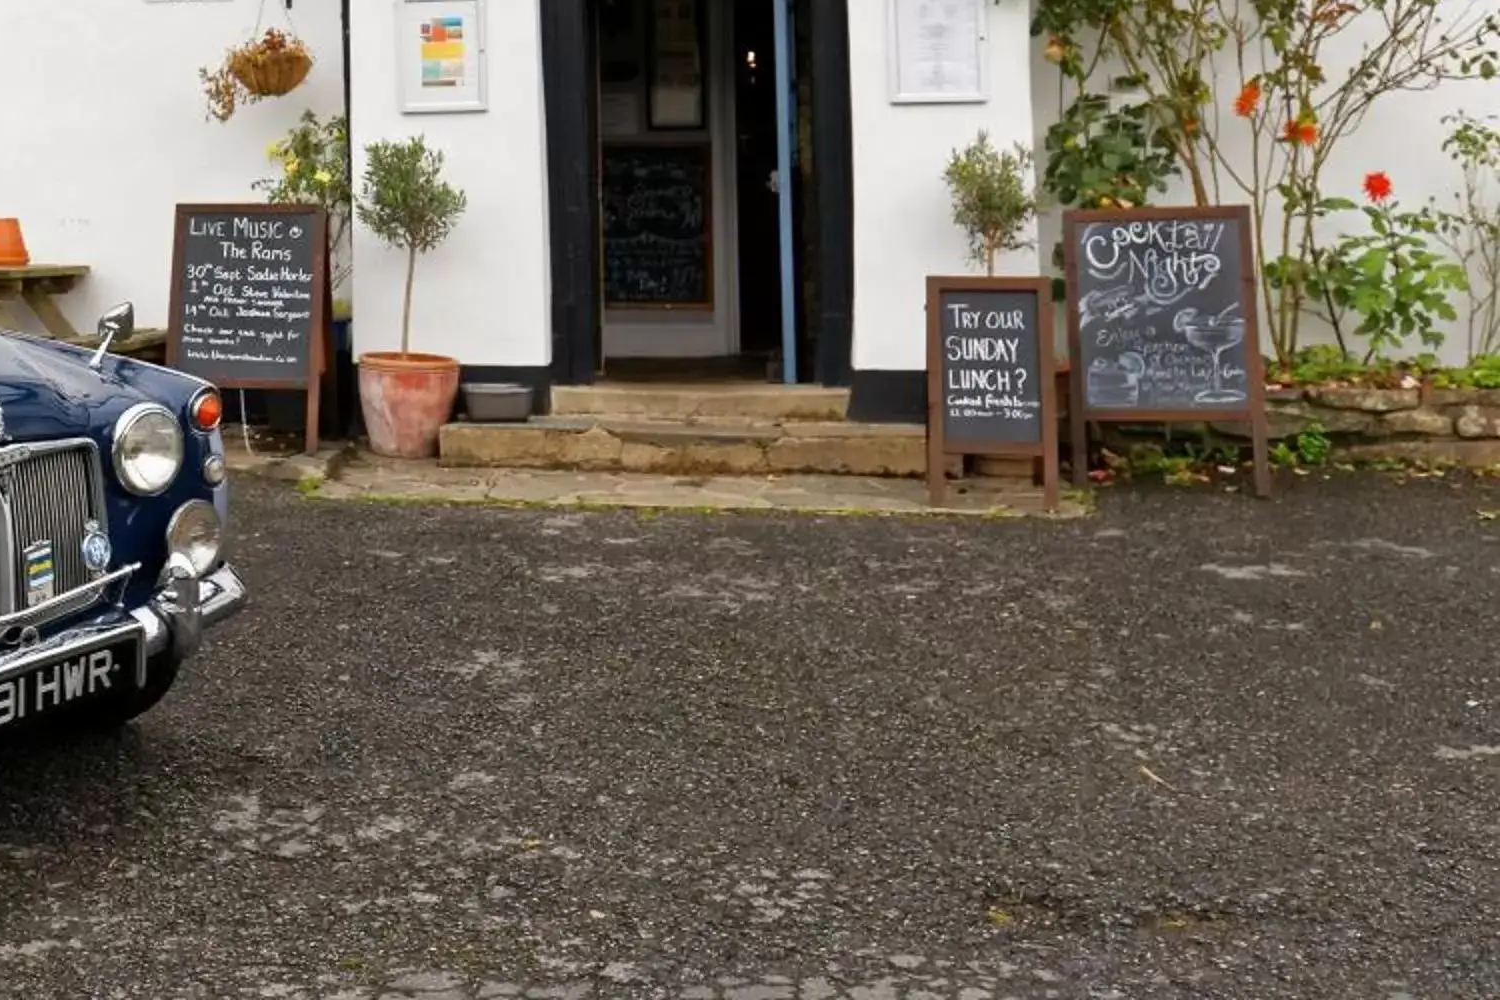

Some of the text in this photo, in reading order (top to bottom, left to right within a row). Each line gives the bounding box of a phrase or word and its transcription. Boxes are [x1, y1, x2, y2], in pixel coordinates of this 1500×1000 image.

[219, 241, 248, 259] The
[945, 335, 1019, 364] SUNDAY
[36, 650, 113, 712] HWR
